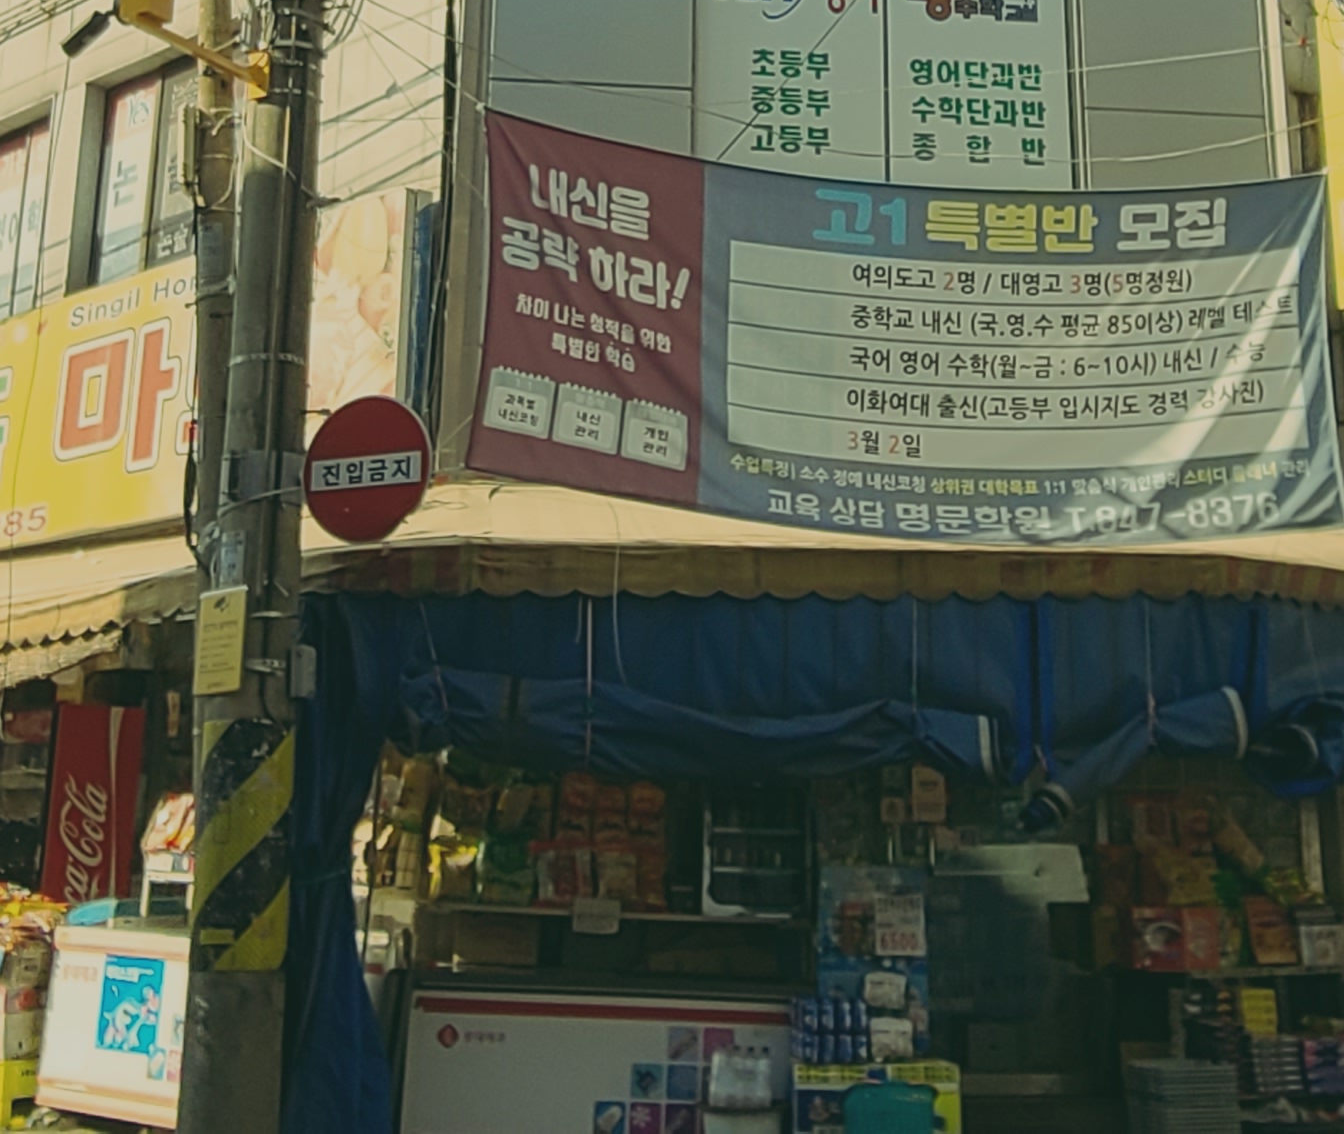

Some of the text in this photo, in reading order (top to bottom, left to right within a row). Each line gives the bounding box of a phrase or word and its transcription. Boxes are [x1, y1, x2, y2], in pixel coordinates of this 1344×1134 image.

[750, 48, 831, 80] 초등부
[909, 59, 1043, 92] 영어단과반
[750, 85, 831, 117] 중등부
[911, 96, 1047, 129] 수학단과반
[750, 124, 831, 156] 고등부
[1020, 137, 1047, 167] 반
[528, 163, 651, 241] 내신을
[812, 187, 1228, 254] 고1 특별반 모집
[501, 216, 691, 311] 공략 하라!
[851, 263, 937, 291] 여의도고
[942, 270, 977, 296] 2명
[1000, 270, 1063, 297] 대영고
[1069, 268, 1194, 298] 3명(5명정원)
[69, 273, 197, 329] Singil Ho
[515, 292, 551, 322] 차이
[553, 303, 586, 330] 나는
[639, 327, 673, 355] 위한
[850, 304, 915, 332] 중학교
[921, 310, 963, 336] 내신
[1059, 312, 1101, 339] 평균
[1106, 311, 1185, 337] 85이상)
[1188, 306, 1227, 331] 레벨
[550, 331, 601, 364] 특별한
[849, 345, 892, 374] 국어
[898, 351, 941, 377] 영어
[1163, 350, 1203, 375] 내신
[1224, 340, 1268, 366] 수능
[53, 316, 197, 474] 마
[846, 379, 1265, 421] 이화여대 출신(고등부 입시지도 경력 강사진)
[574, 424, 600, 442] 관리
[575, 409, 602, 427] 내신
[642, 425, 670, 444] 개인
[642, 440, 669, 458] 관리
[848, 429, 922, 459] 3월 2일
[321, 455, 413, 487] 진입금지
[799, 465, 830, 484] 소수
[866, 473, 927, 495] 내신코칭
[930, 476, 975, 496] 상위권
[978, 477, 1040, 498] 대학목표
[1043, 481, 1067, 495] 1:1
[766, 488, 1281, 537] 교육 상담 명문학원 T.847-8376
